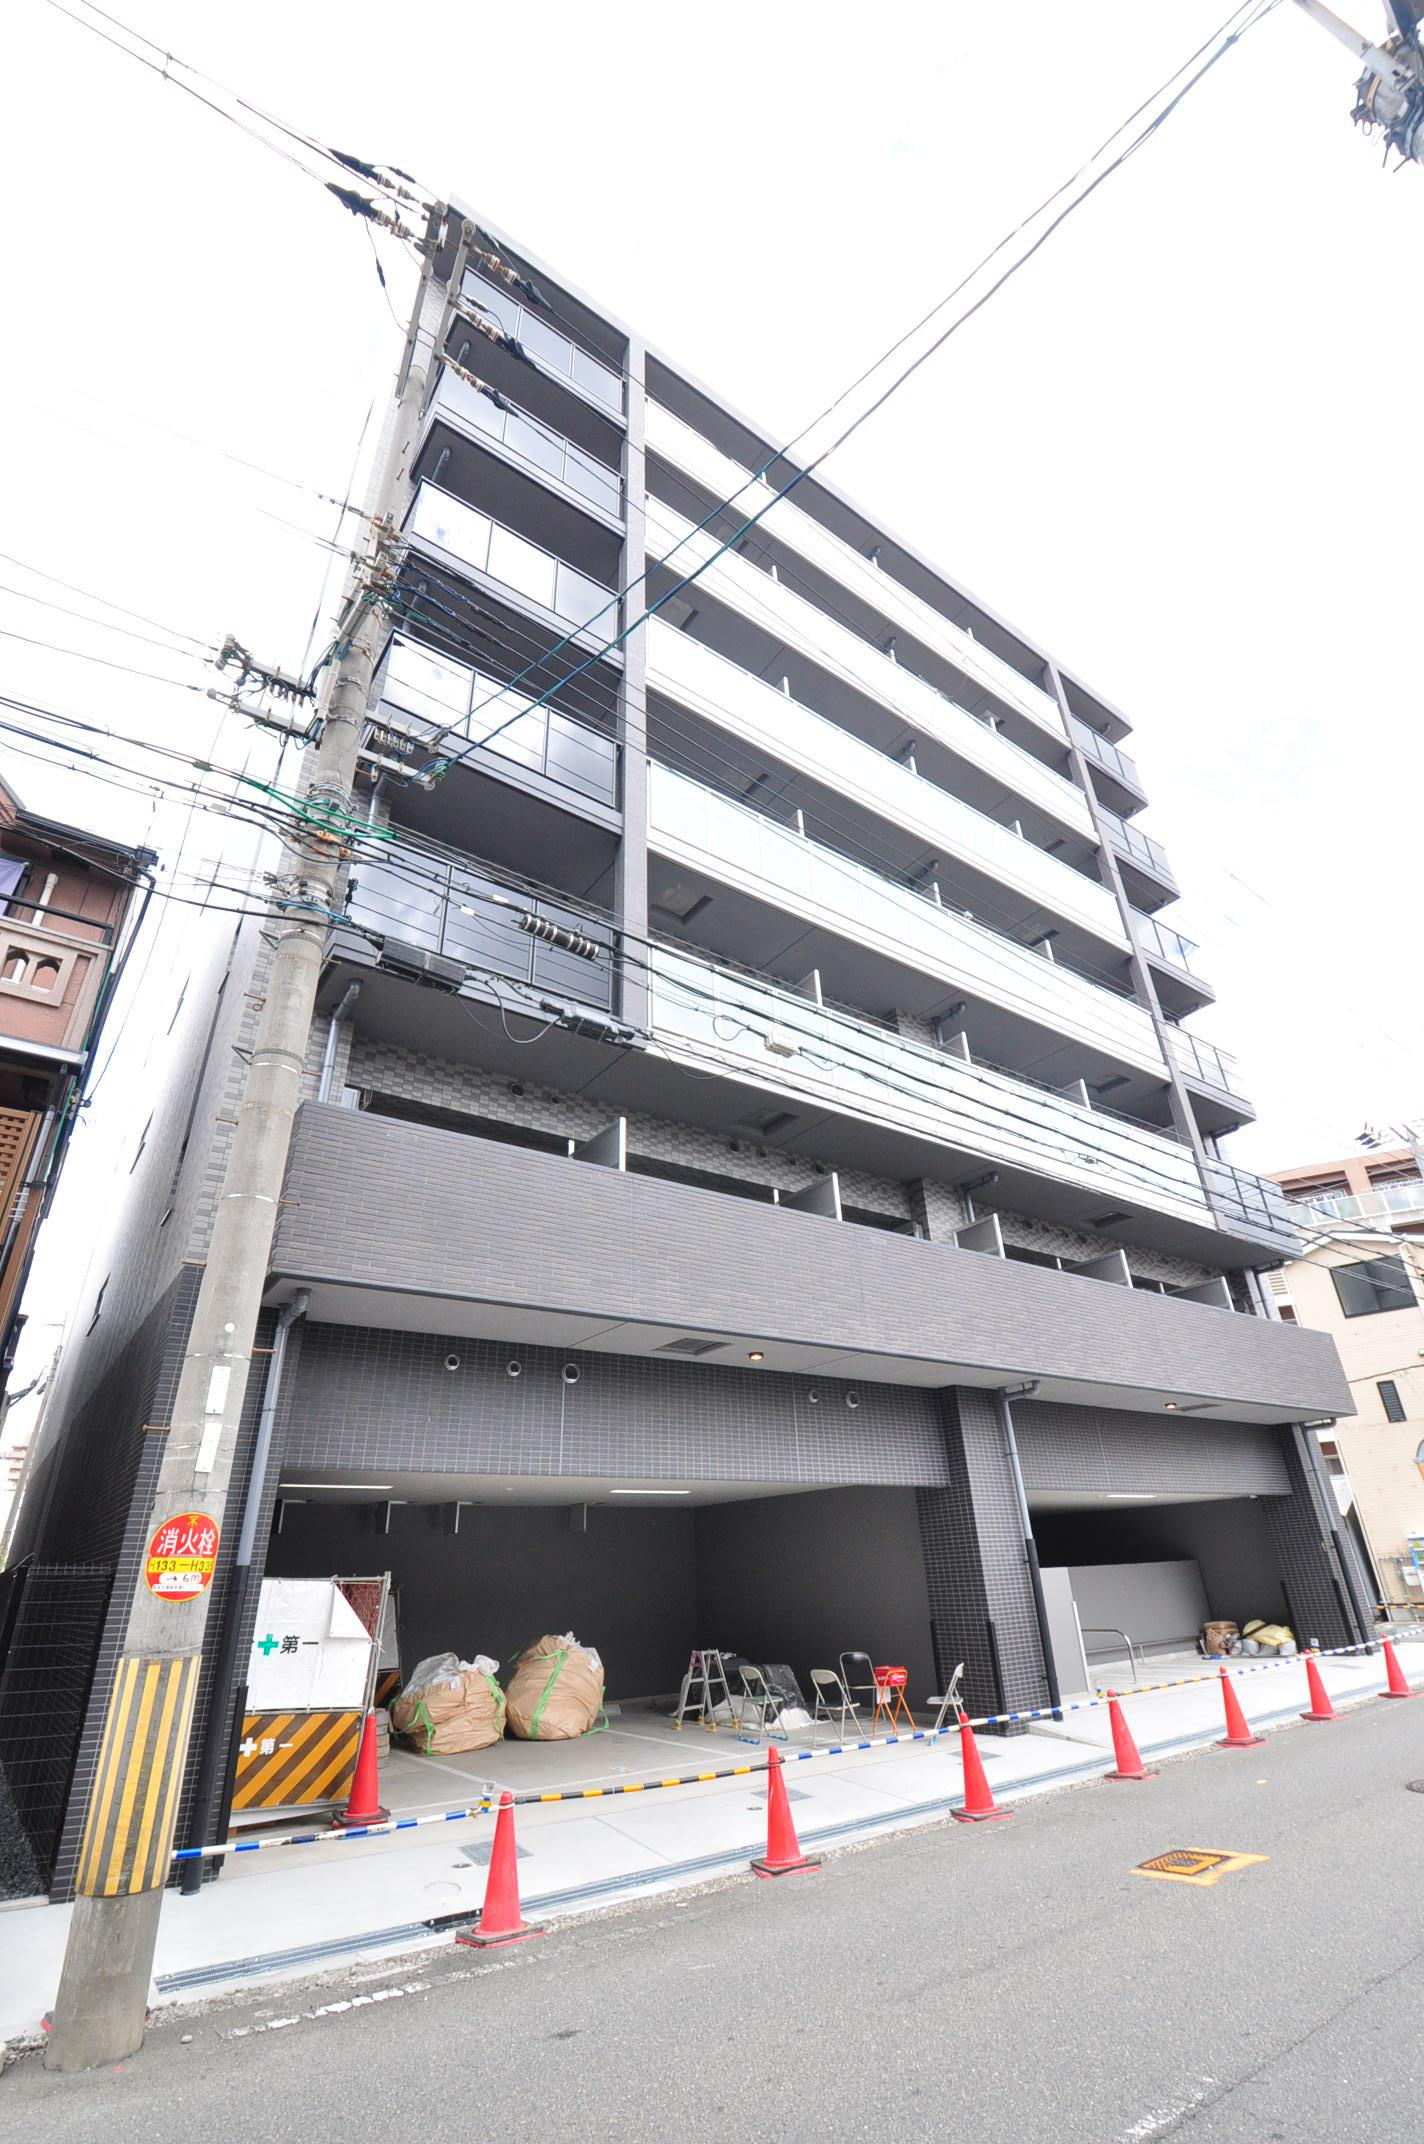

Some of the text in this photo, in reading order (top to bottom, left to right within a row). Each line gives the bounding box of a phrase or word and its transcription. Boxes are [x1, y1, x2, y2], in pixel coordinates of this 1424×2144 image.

[157, 1527, 216, 1555] 消火栓
[280, 1634, 319, 1655] 第一
